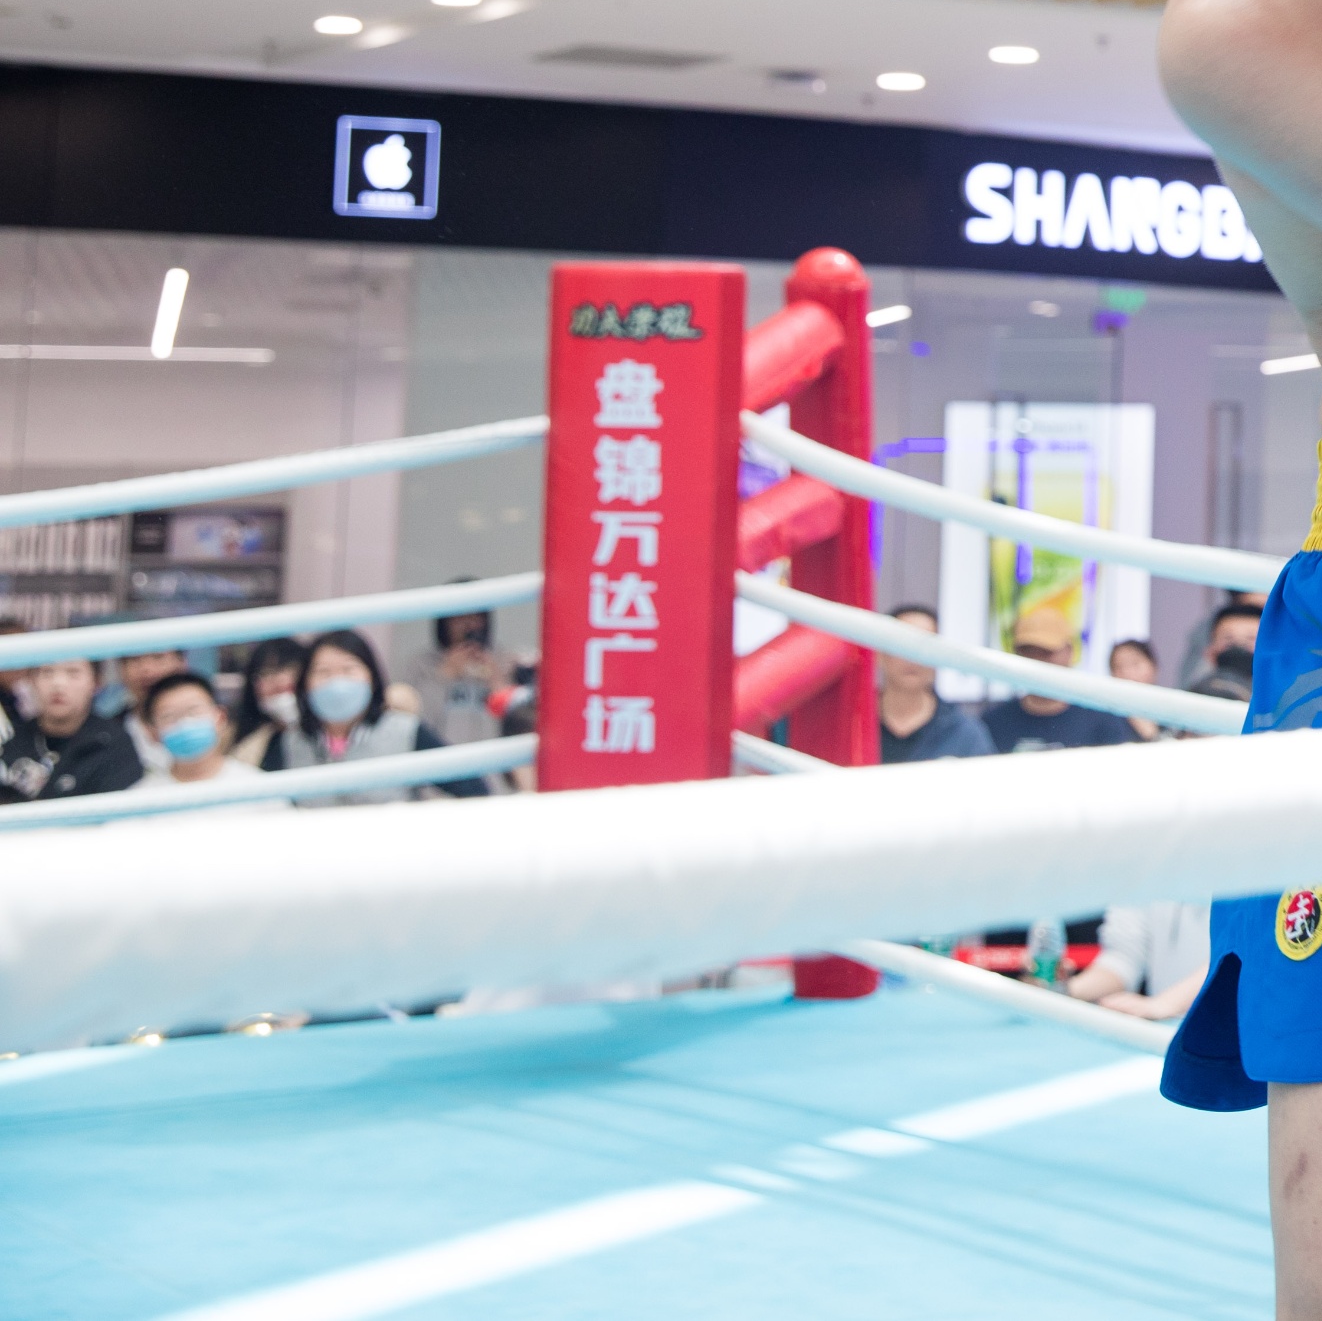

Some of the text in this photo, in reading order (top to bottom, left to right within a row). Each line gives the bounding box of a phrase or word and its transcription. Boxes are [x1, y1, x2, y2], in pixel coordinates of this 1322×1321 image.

[582, 359, 664, 753] 盘锦万达广场
